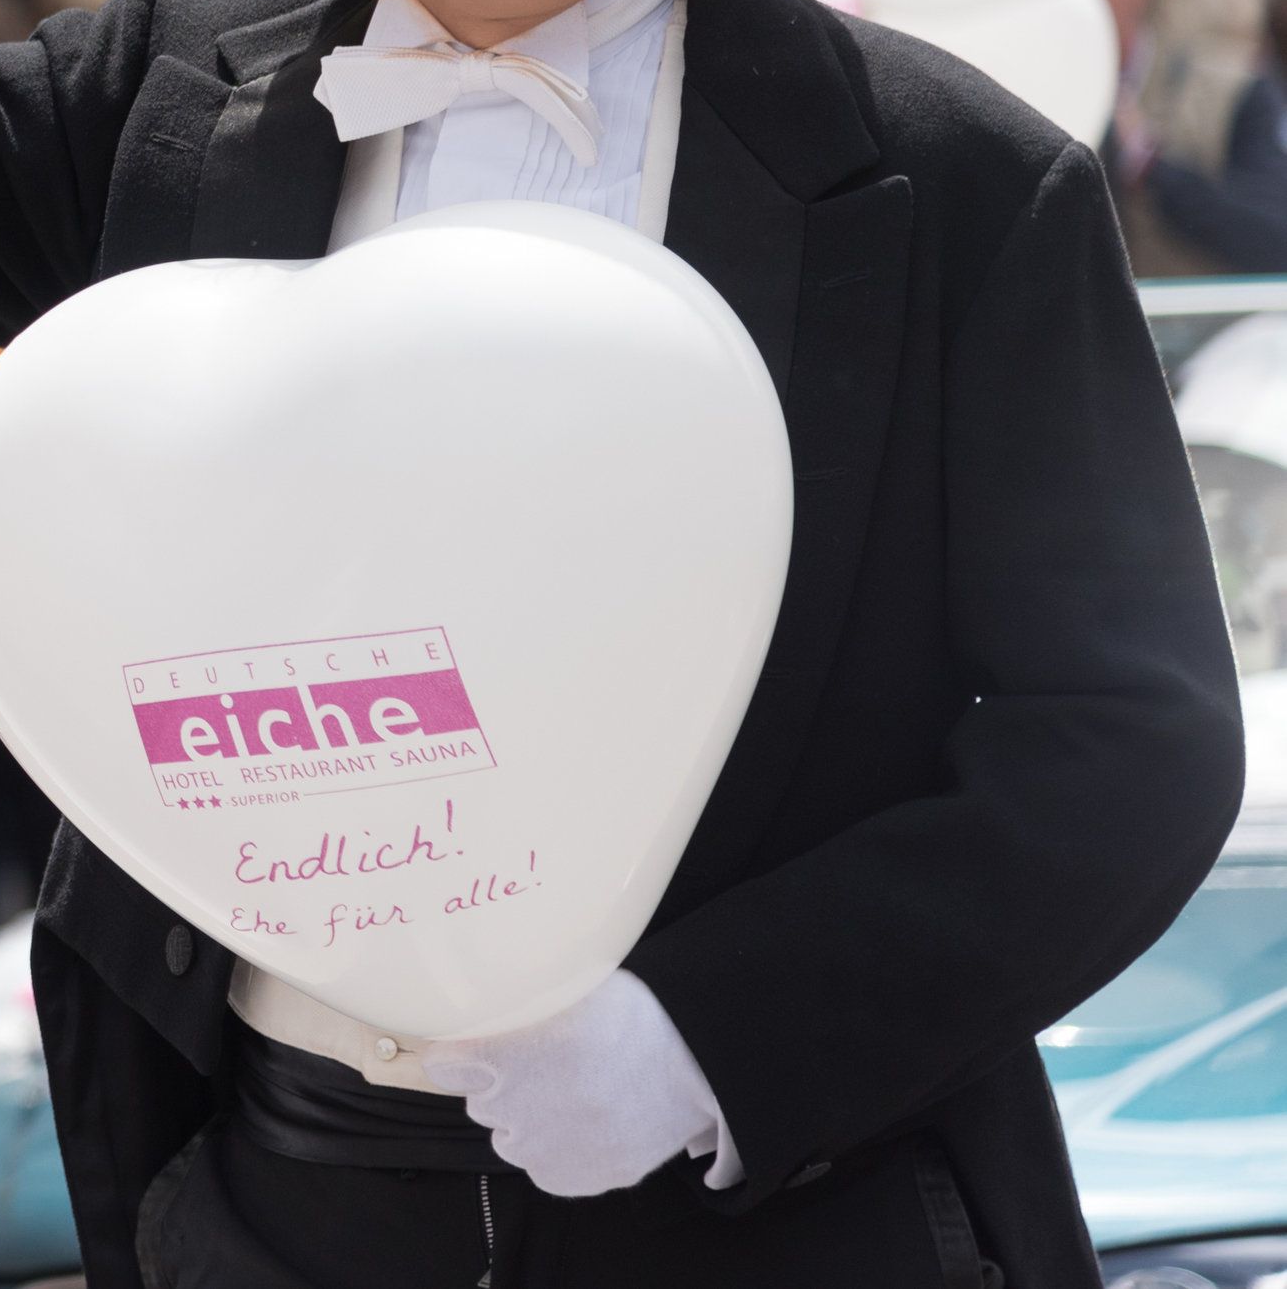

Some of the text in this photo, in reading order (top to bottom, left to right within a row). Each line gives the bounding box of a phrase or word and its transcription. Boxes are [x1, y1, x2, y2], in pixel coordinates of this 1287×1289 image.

[131, 642, 441, 694] DEUTSCHE
[179, 684, 425, 764] eiche
[162, 740, 477, 790] HOTEL RESTAURANT SAUNA
[229, 789, 301, 808] SUPERIOR
[234, 798, 465, 885] Endlich!
[229, 850, 544, 948] Ehe für alle!
